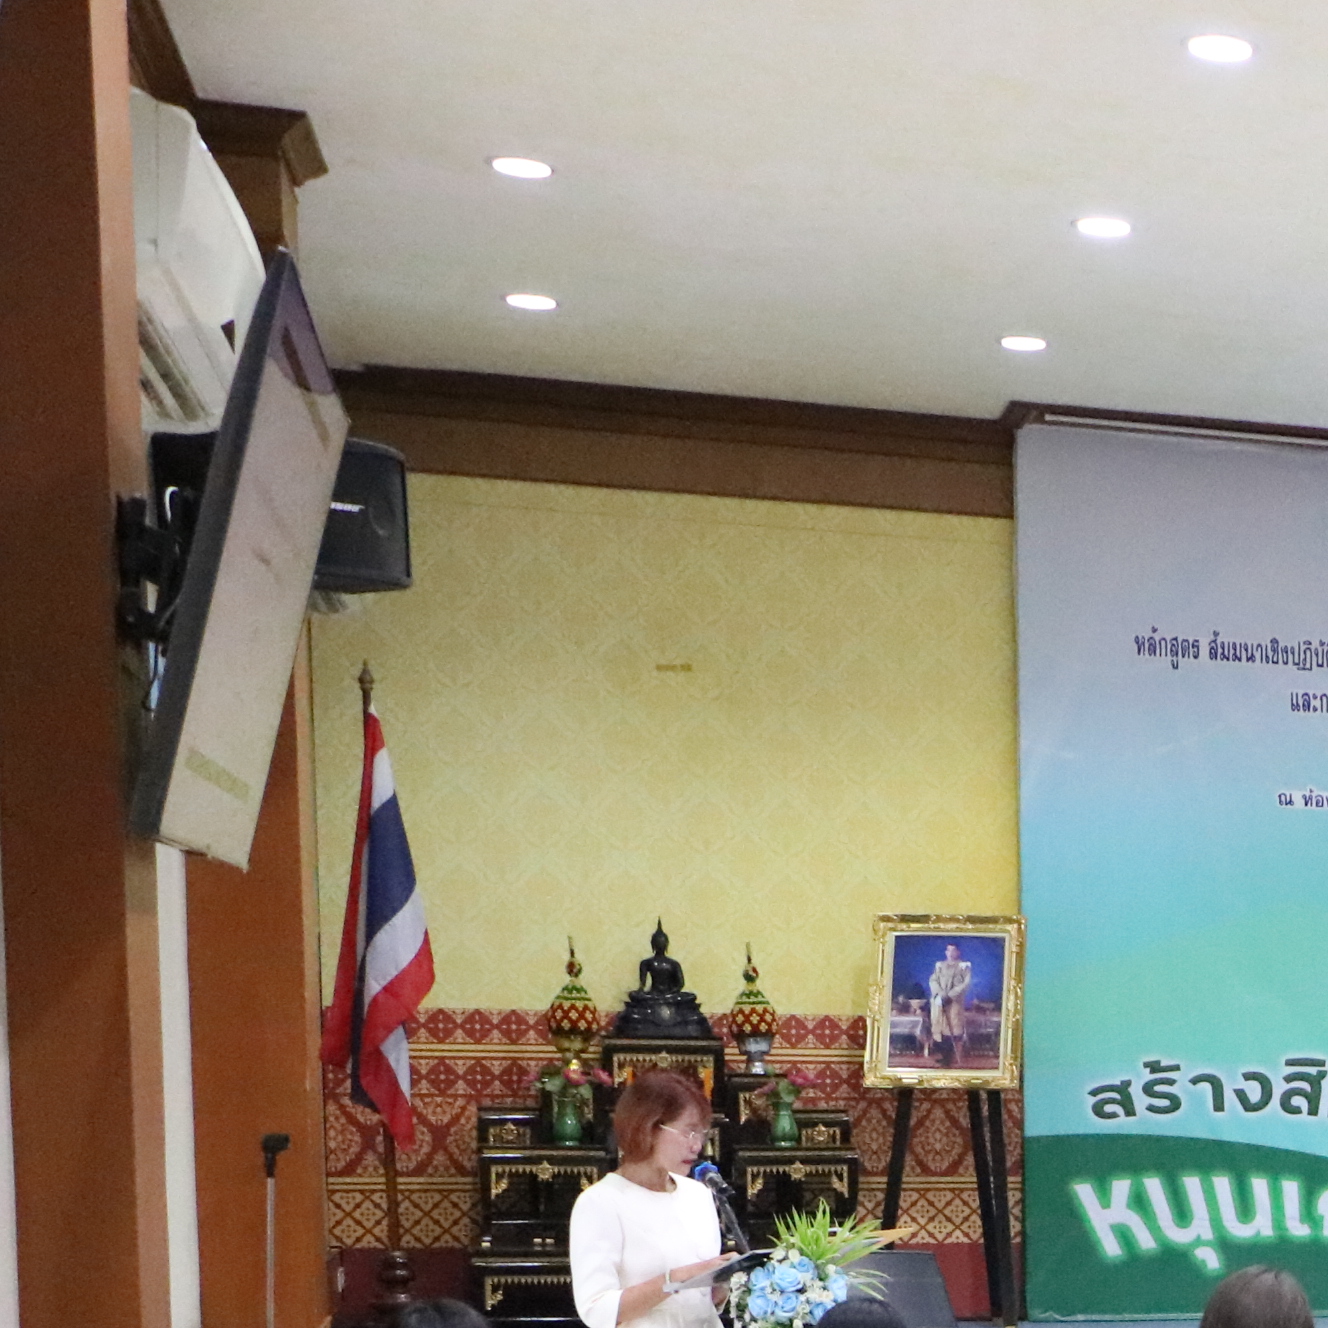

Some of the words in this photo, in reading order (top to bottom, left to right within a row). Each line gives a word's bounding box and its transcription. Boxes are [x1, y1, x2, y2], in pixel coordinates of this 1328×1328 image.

[1134, 626, 1200, 669] หลักสูตร
[1278, 791, 1294, 808] ณ
